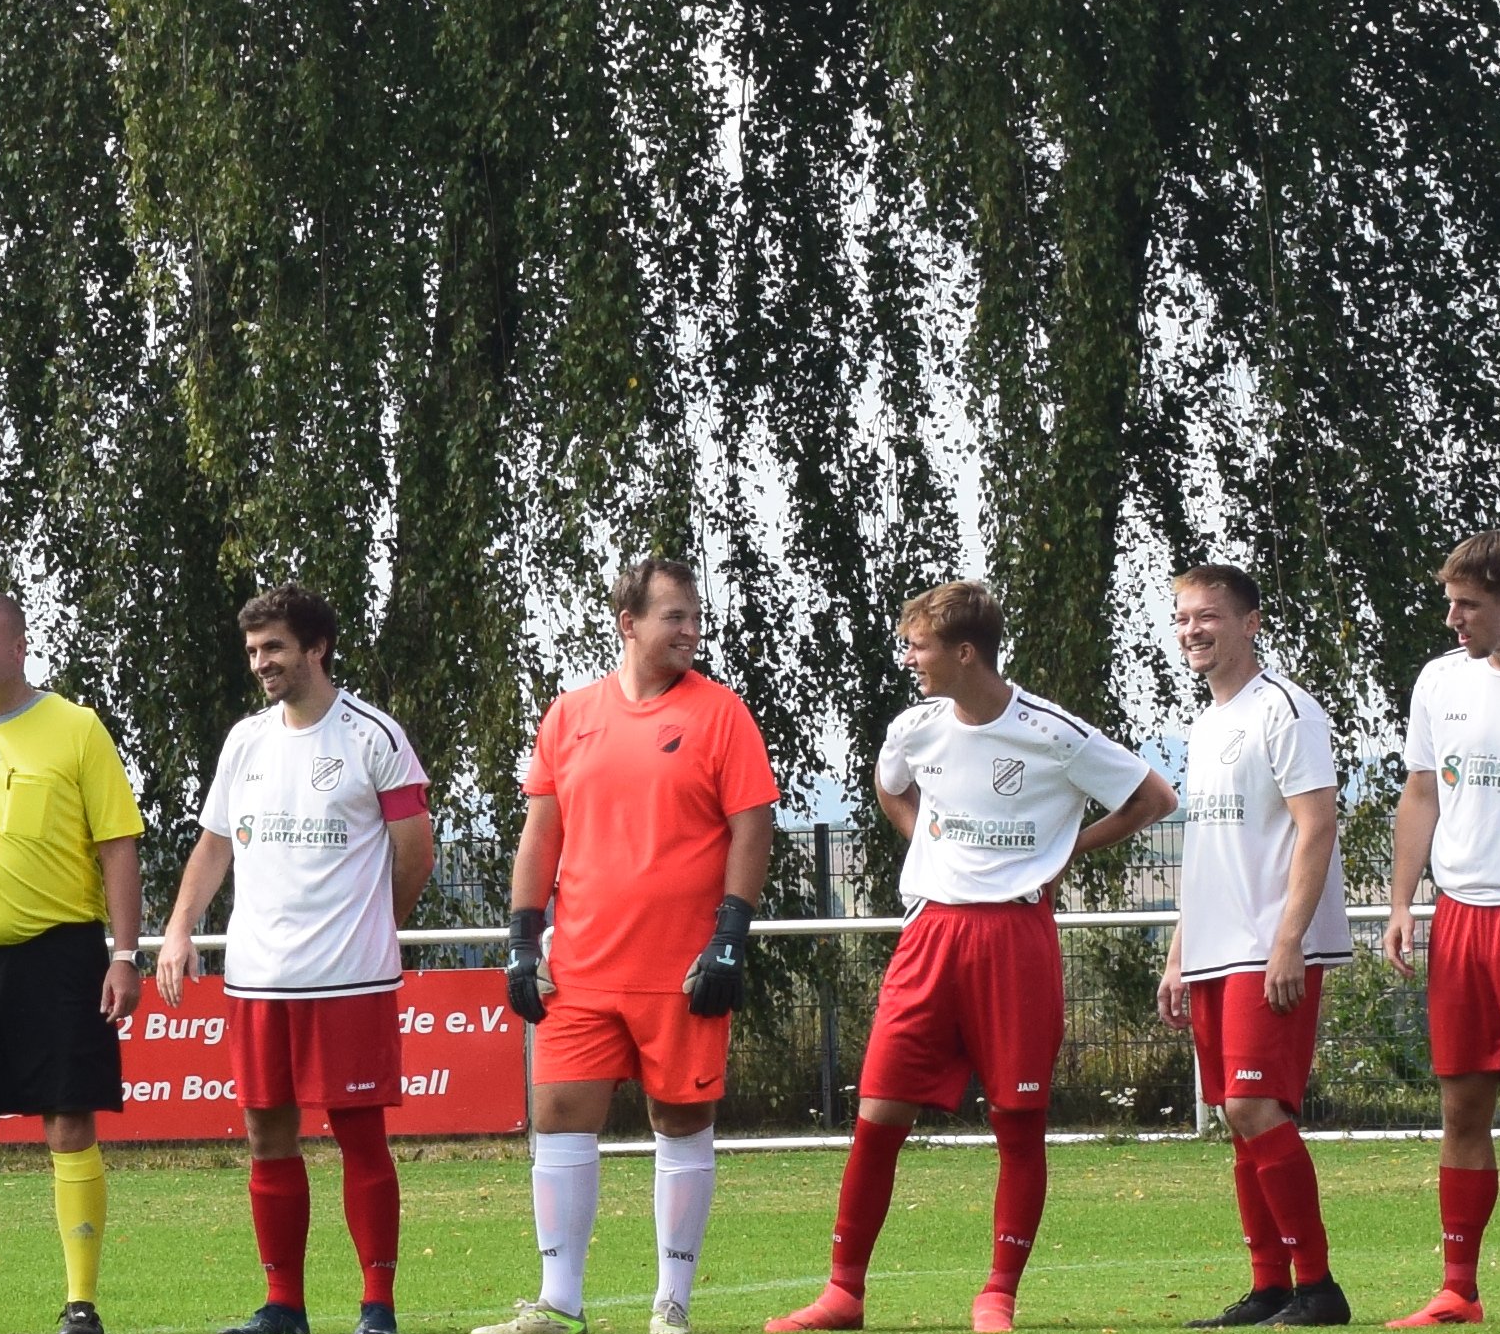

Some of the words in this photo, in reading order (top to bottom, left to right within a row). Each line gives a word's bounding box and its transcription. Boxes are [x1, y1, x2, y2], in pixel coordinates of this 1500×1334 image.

[261, 832, 348, 844] GARTEN-CENTER
[946, 829, 1035, 846] GARTEN-CENTER
[445, 1006, 508, 1033] e.V.
[1235, 1070, 1262, 1080] JAKO
[182, 1075, 237, 1100] Boc
[1017, 1082, 1039, 1092] JAKO
[998, 1233, 1031, 1248] JAKO
[666, 1250, 695, 1262] JAKO
